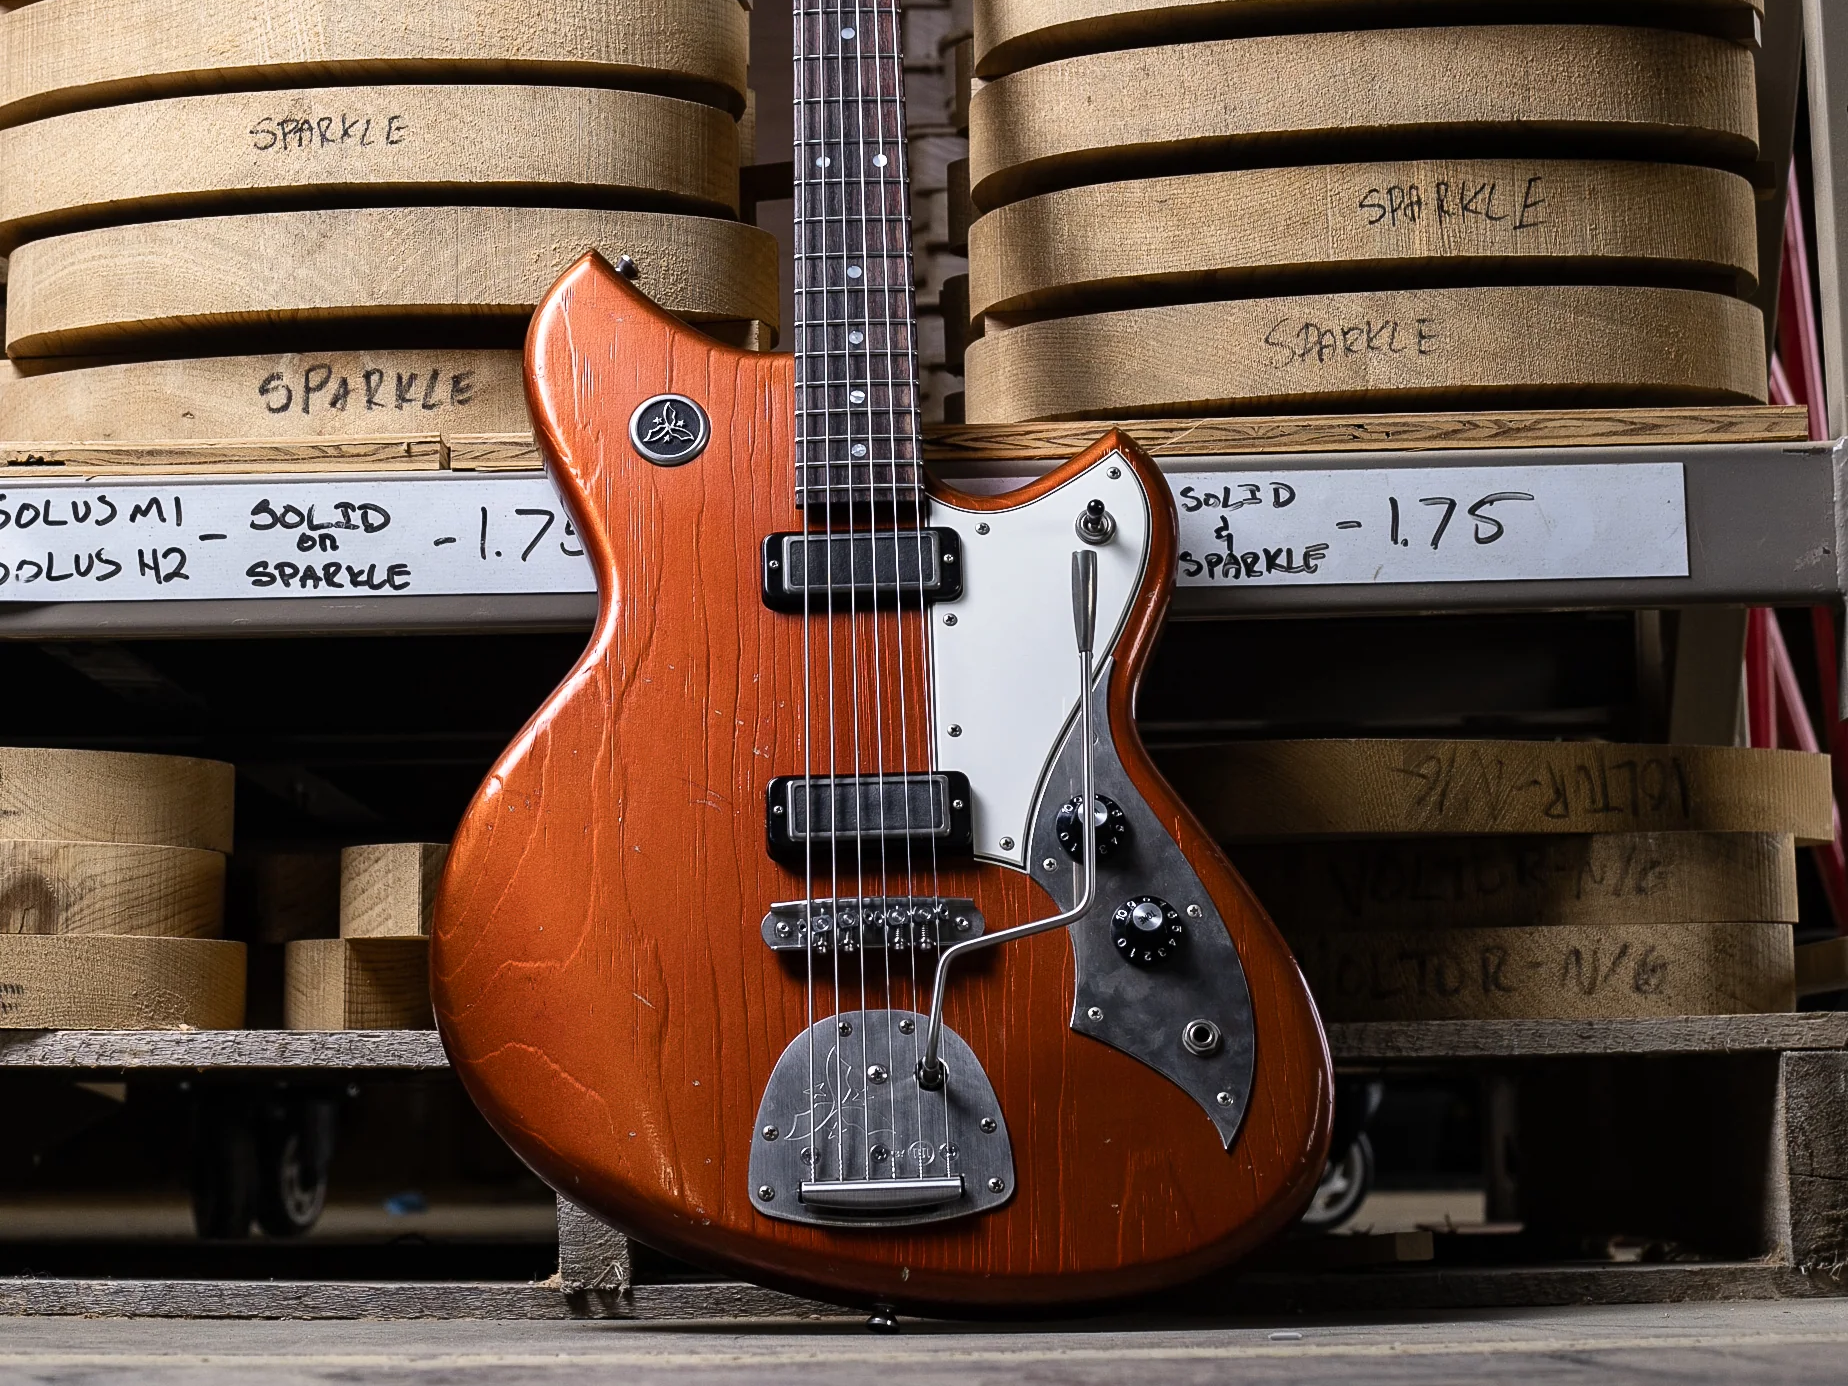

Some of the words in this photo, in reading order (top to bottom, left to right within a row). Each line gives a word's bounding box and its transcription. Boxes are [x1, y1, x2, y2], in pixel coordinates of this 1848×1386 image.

[249, 114, 409, 151] SPARKLE
[1359, 176, 1547, 232] SPARKLE
[1264, 318, 1440, 370] SPARKLE
[258, 364, 477, 415] SPARKLE
[129, 496, 183, 526] M1
[1179, 482, 1296, 512] SOLID
[250, 499, 392, 534] SOLID
[137, 546, 190, 584] H2
[245, 560, 412, 591] SPARKLE
[1178, 543, 1330, 580] SPARKLE
[1115, 909, 1128, 921] 10
[1138, 910, 1158, 925] TONE
